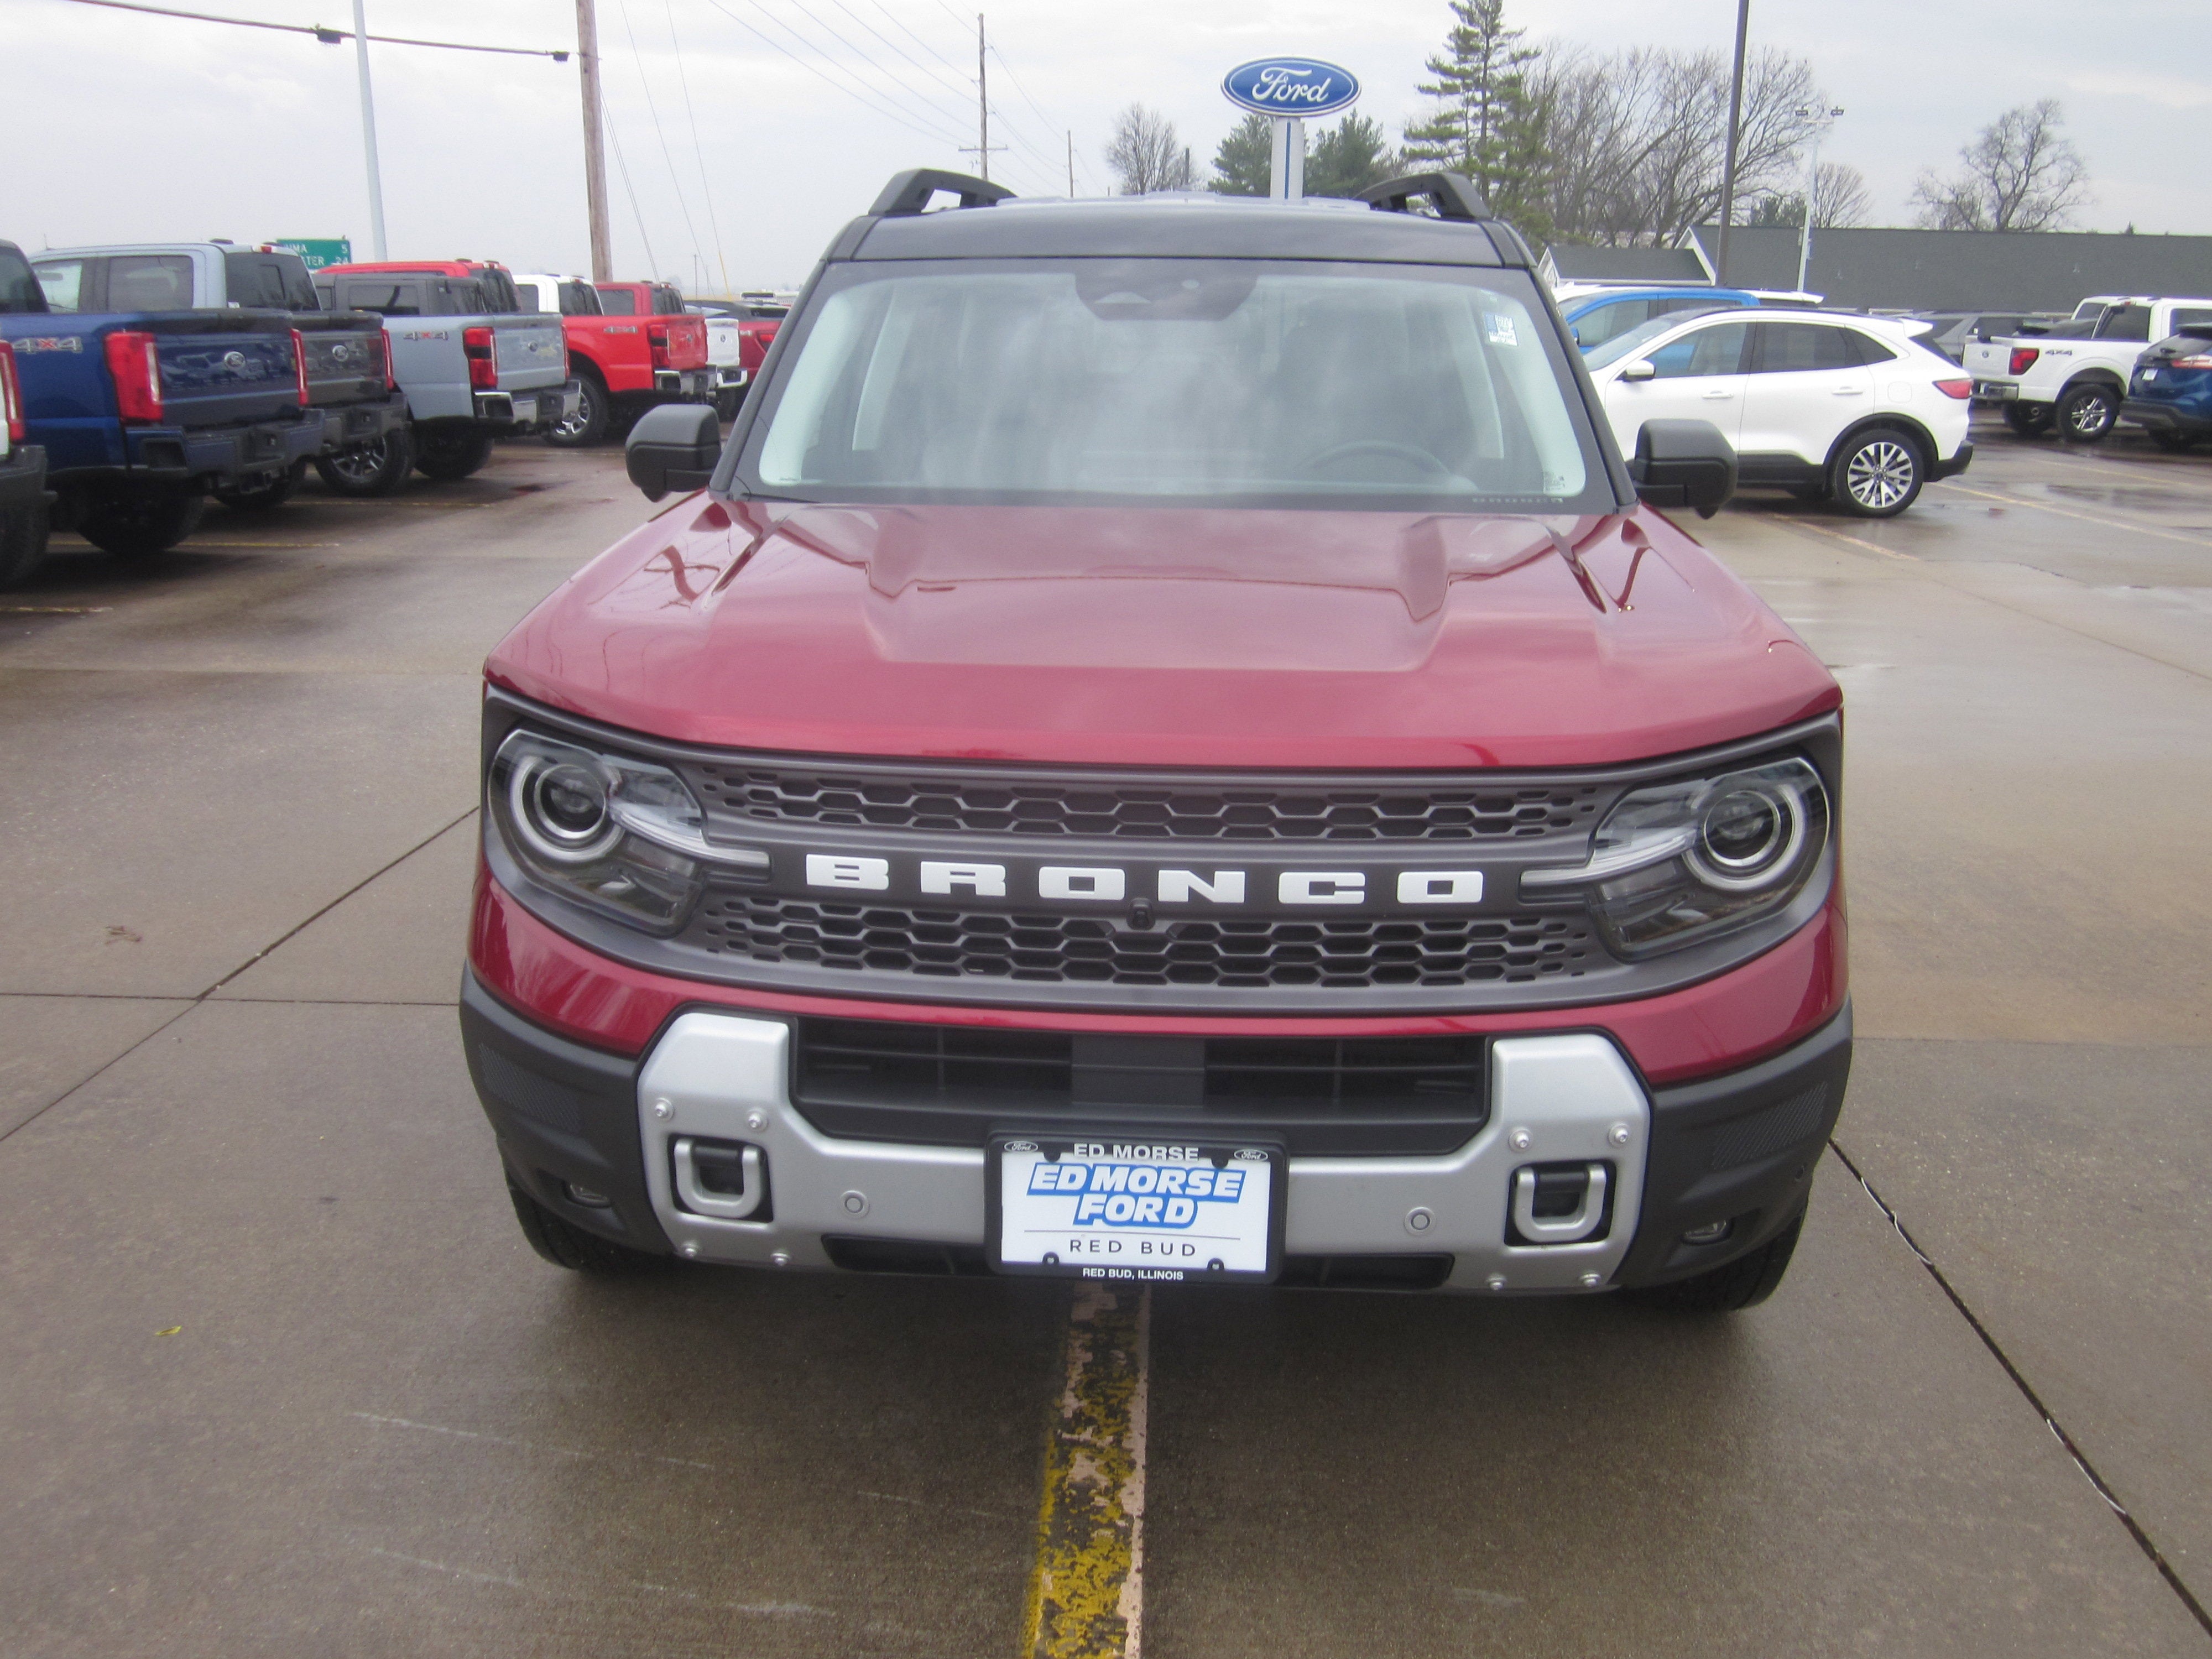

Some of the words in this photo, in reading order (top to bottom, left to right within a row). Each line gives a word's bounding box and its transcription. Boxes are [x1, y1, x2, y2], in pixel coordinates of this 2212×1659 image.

[1252, 67, 1331, 102] Ford
[341, 244, 348, 254] 5
[806, 854, 1483, 904] BRONCO
[1074, 1143, 1105, 1157] ED
[1113, 1145, 1199, 1161] MORSE
[1030, 1164, 1088, 1191] ED
[1090, 1166, 1243, 1197] MORSE
[1077, 1193, 1194, 1224] FORD
[1070, 1239, 1122, 1253] RED
[1141, 1241, 1196, 1256] BUD
[1082, 1267, 1105, 1278] RED
[1108, 1269, 1135, 1280] BUD,
[1138, 1270, 1183, 1280] ILLINOIS
